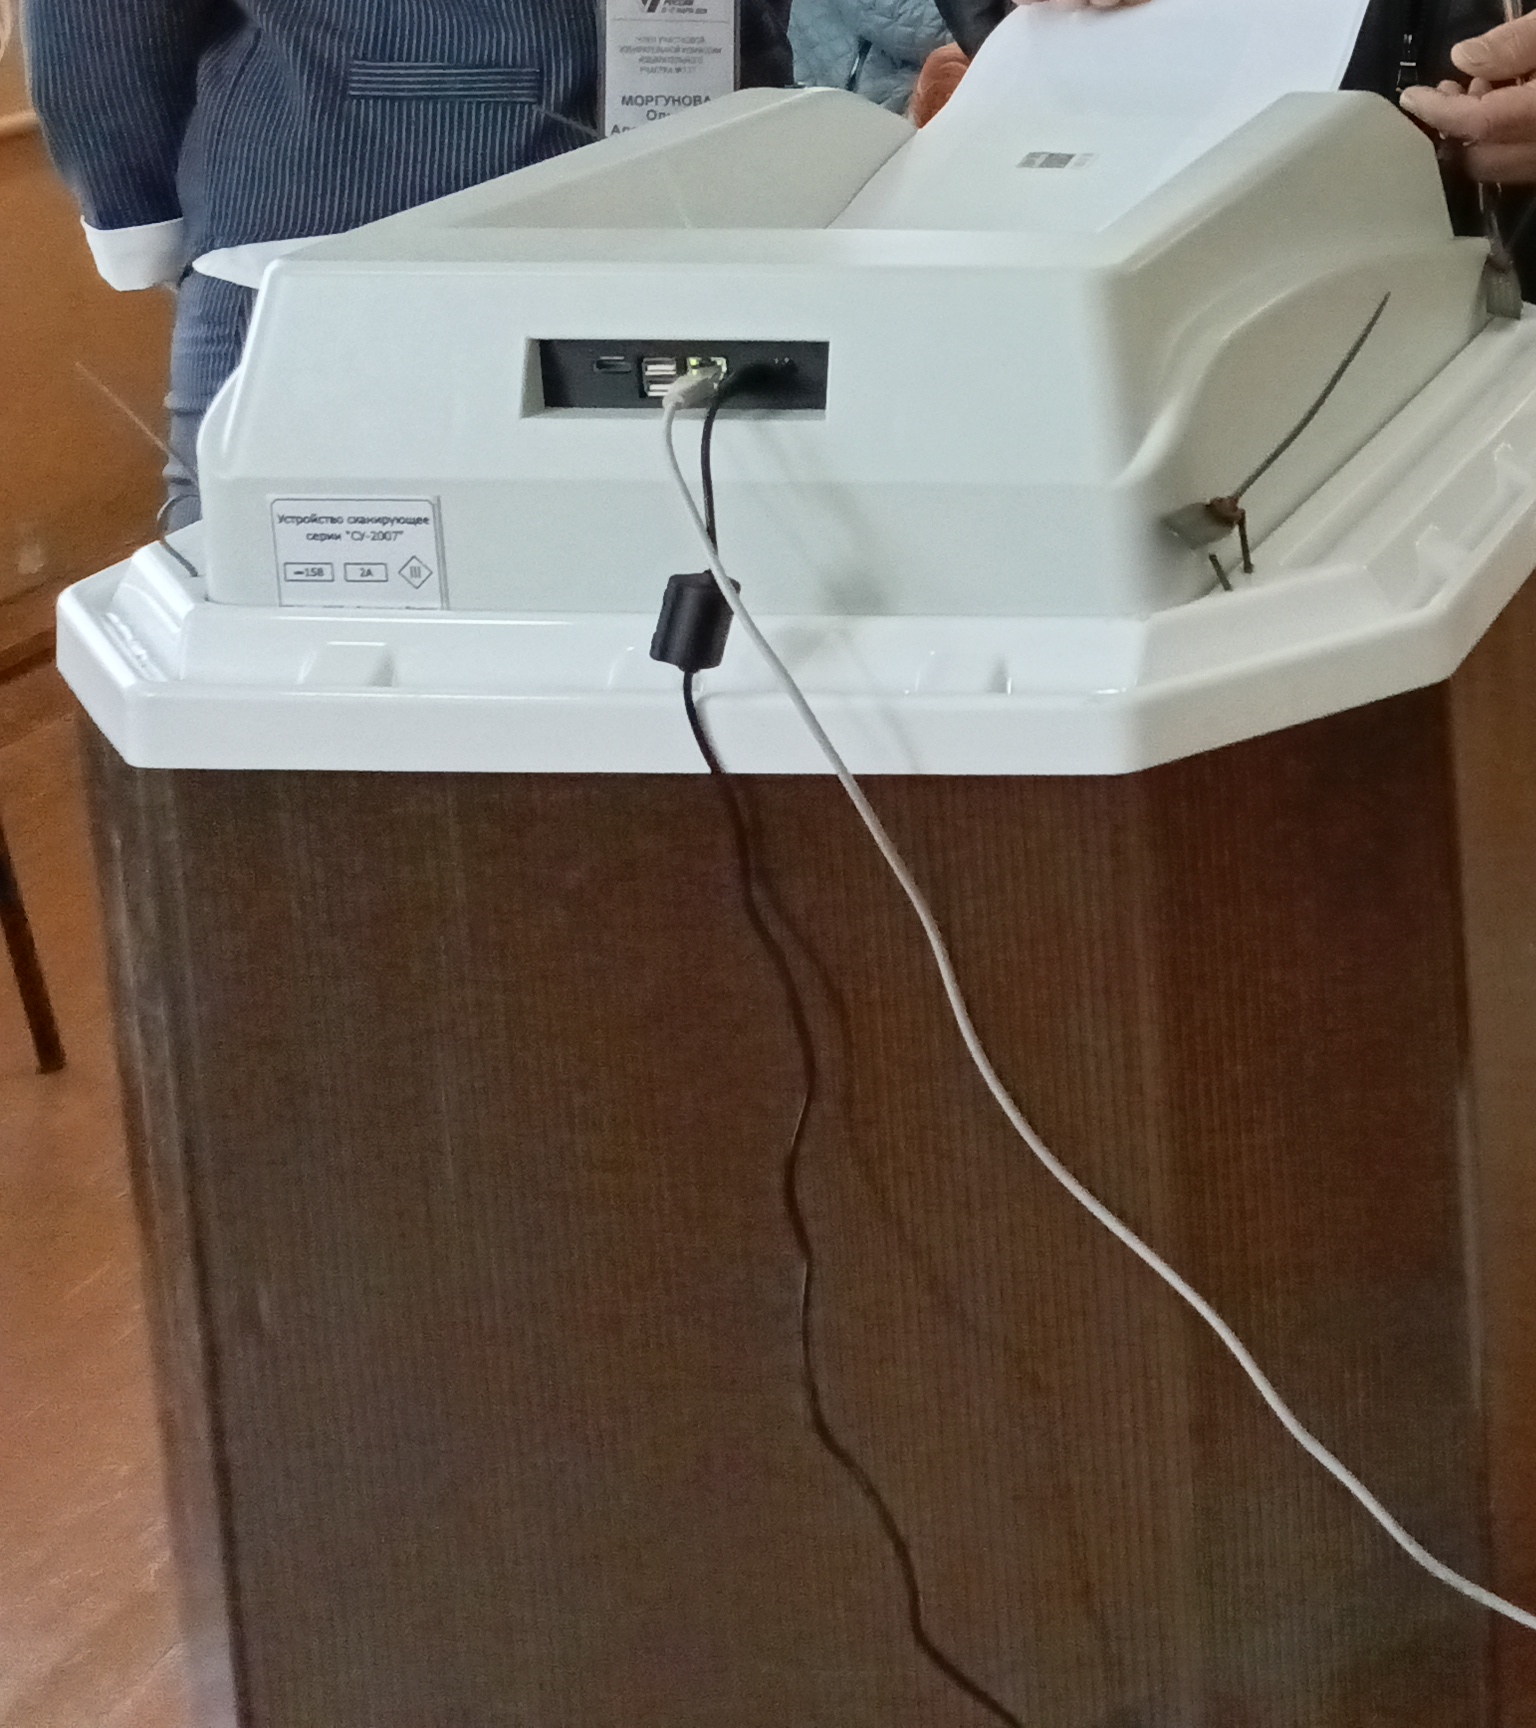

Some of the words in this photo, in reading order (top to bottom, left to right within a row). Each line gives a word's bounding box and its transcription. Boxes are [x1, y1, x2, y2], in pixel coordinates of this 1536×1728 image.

[277, 513, 344, 526] Устройство
[347, 515, 430, 526] сканирующее
[306, 531, 342, 542] серии
